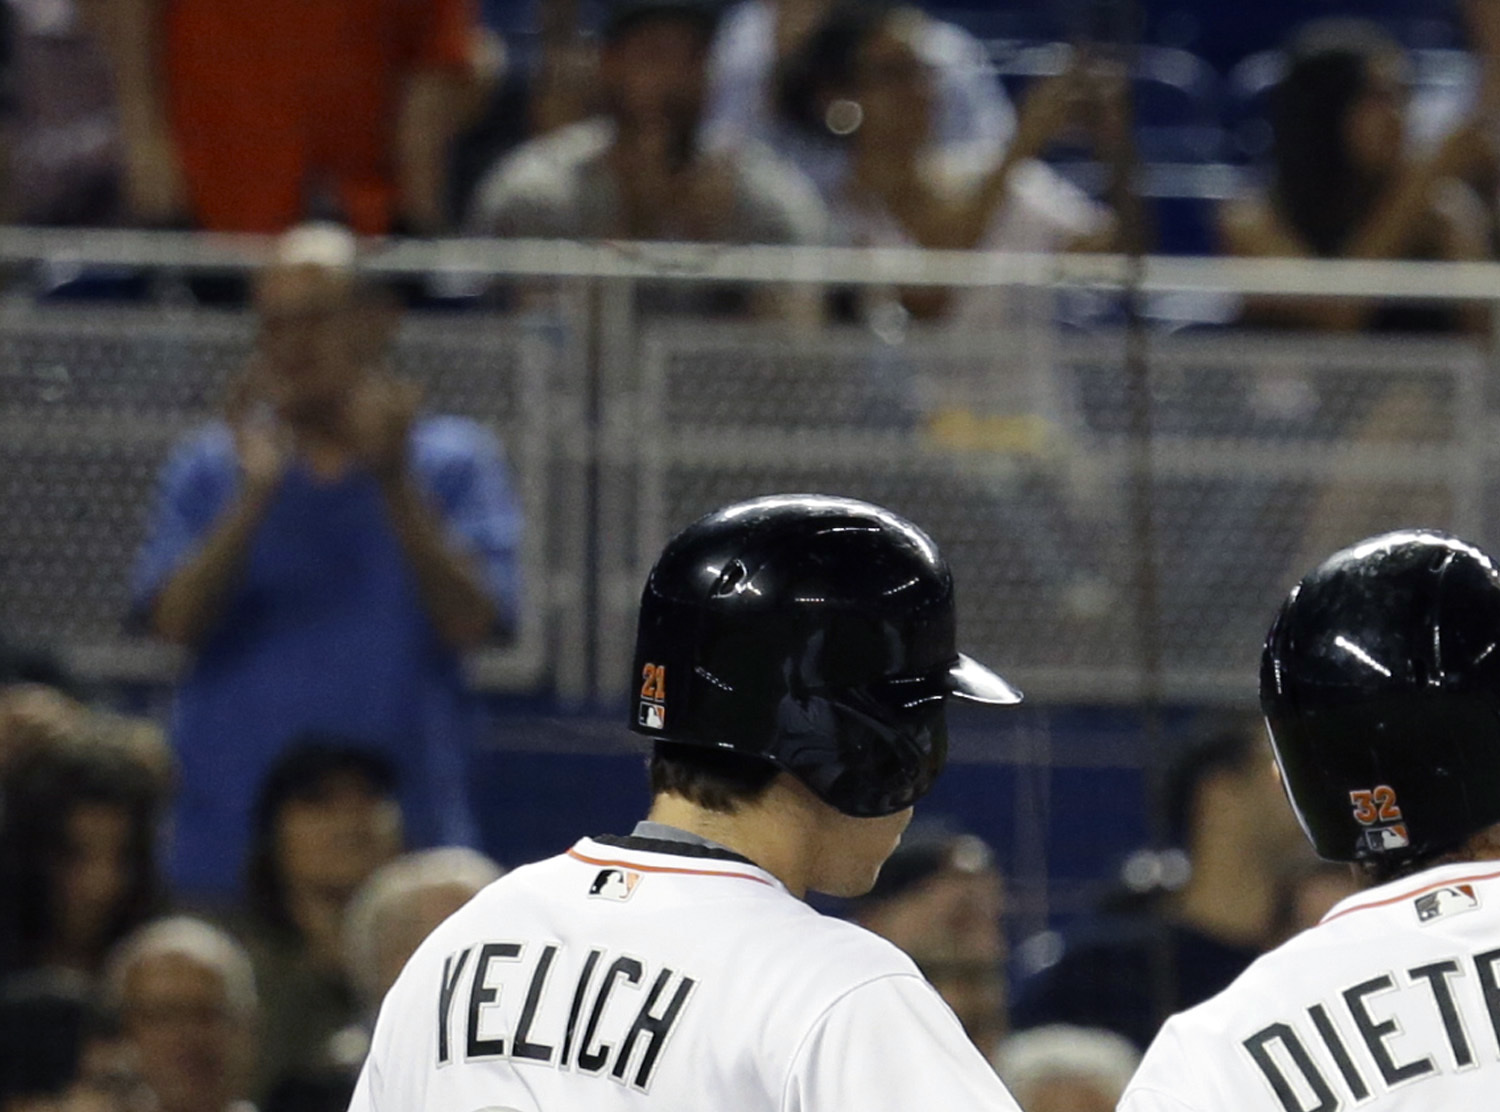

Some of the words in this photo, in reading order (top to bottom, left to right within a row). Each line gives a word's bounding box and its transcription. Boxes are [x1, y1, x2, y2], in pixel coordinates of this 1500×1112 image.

[641, 663, 665, 702] 21
[1349, 785, 1402, 825] 32
[437, 941, 700, 1095] YELICH
